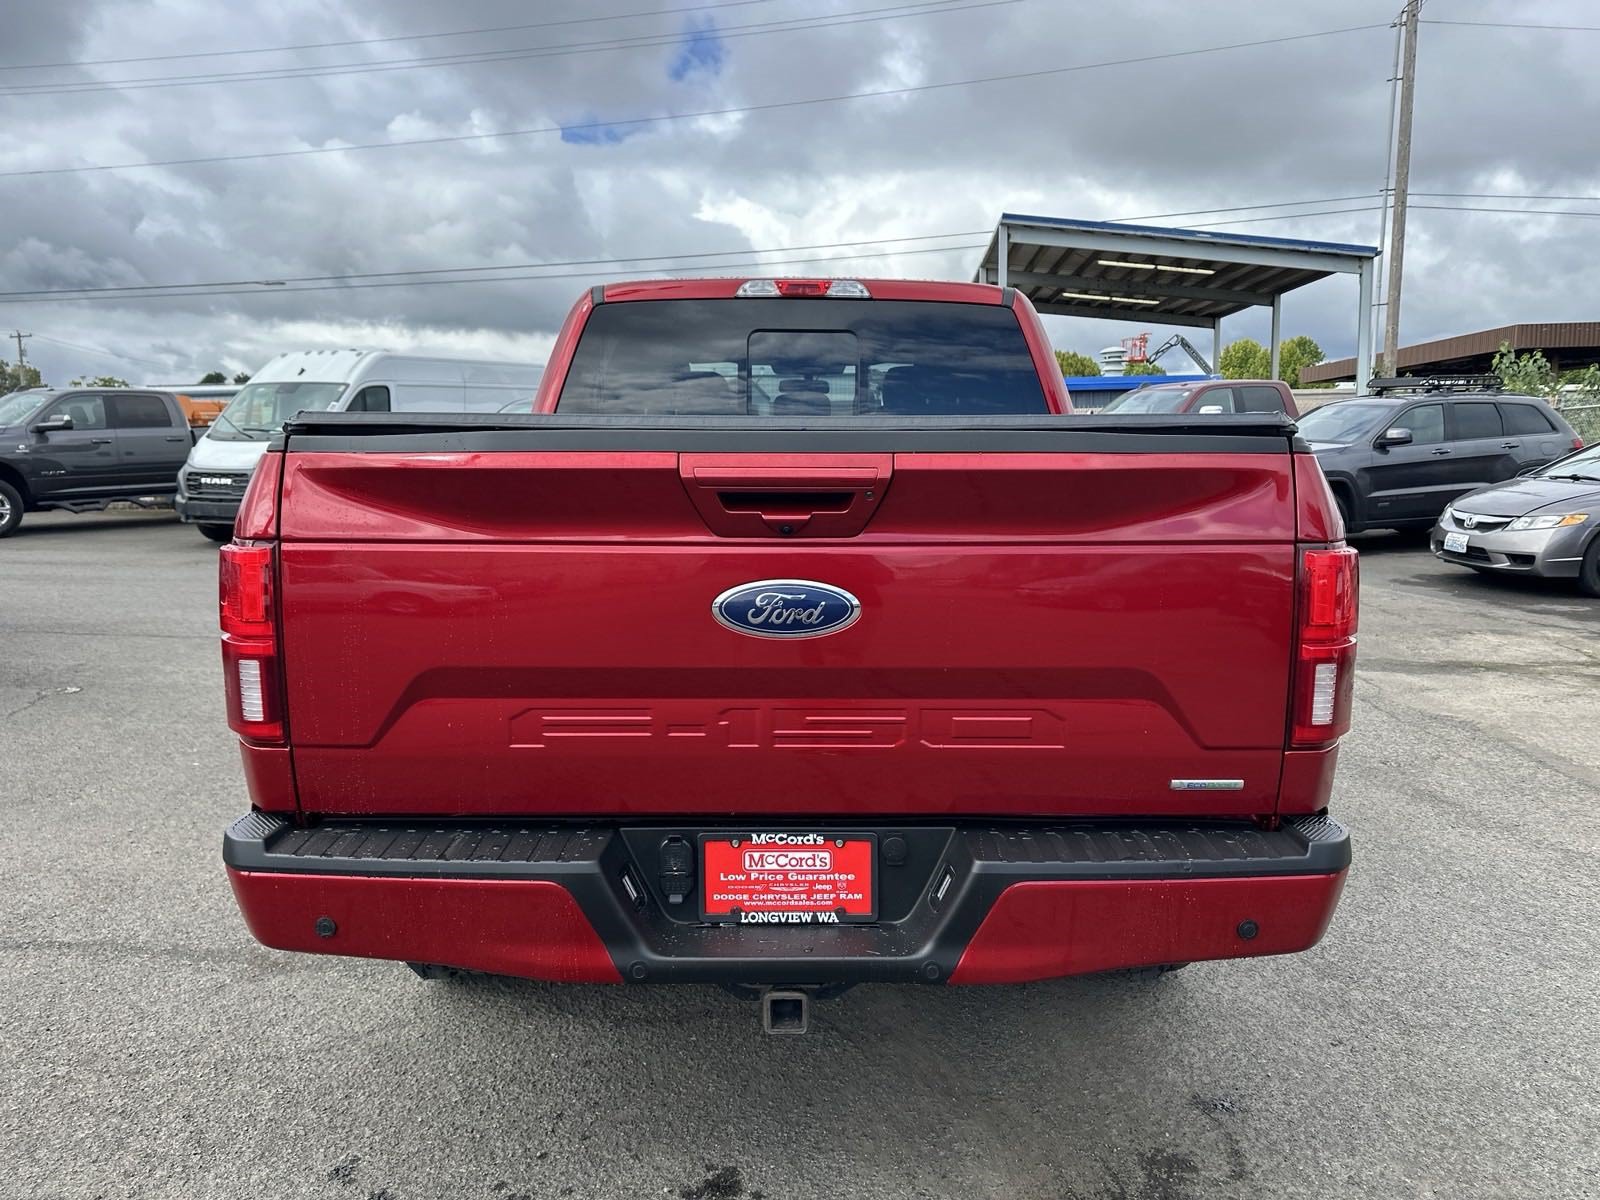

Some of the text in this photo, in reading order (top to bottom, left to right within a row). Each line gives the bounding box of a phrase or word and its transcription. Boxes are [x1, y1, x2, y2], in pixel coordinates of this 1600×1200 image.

[200, 477, 232, 485] RAM
[747, 592, 826, 625] Ford
[508, 707, 1066, 749] F-150
[751, 833, 825, 845] McCord's
[747, 854, 828, 868] McCord's
[720, 873, 856, 881] Low Price Guarantee
[812, 883, 832, 891] Jeep
[740, 912, 839, 923] LONGVIEW WA
